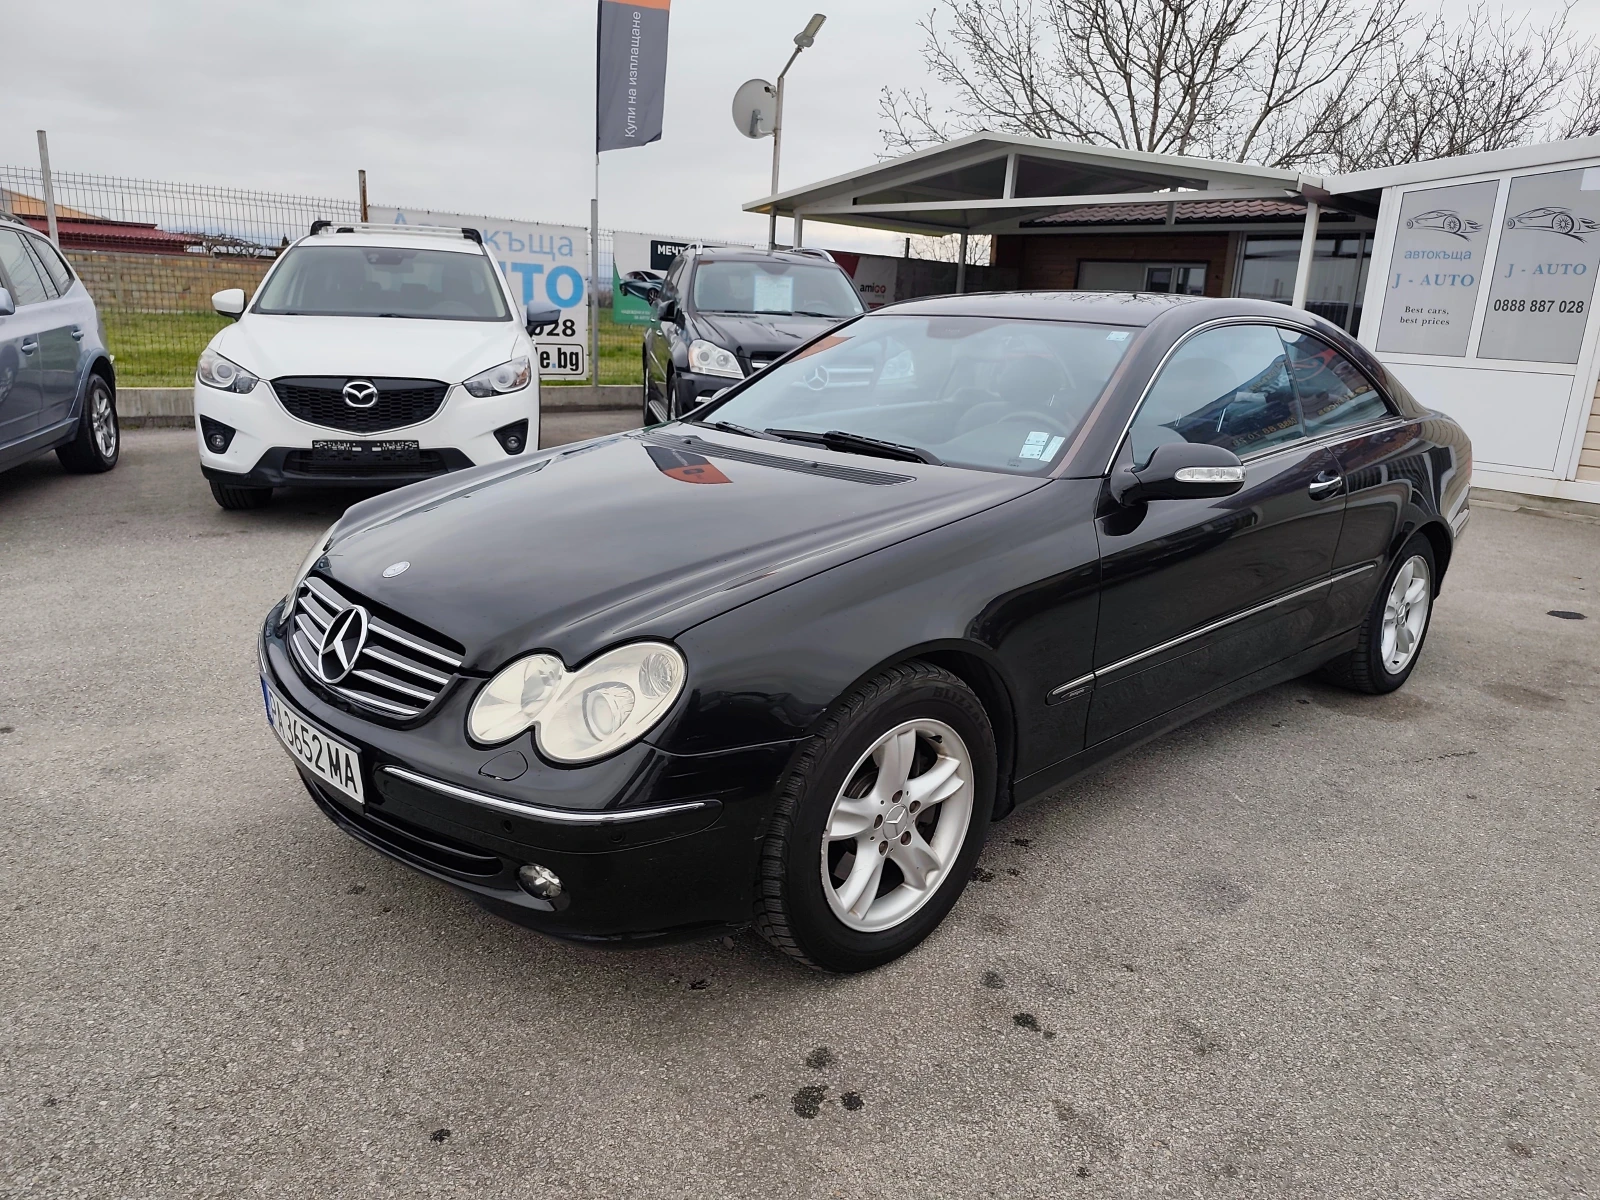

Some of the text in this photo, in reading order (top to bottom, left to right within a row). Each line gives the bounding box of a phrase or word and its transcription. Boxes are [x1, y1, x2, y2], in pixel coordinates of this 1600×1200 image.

[625, 11, 642, 138] Купи на изплащане
[1404, 250, 1472, 261] автокъща
[1504, 263, 1515, 278] J
[1532, 263, 1587, 275] AUTO
[1391, 273, 1402, 289] J
[1420, 273, 1475, 287] AUTO
[1404, 305, 1424, 314] Best
[1493, 299, 1585, 314] 0888 887 028
[1400, 316, 1450, 326] best prices
[535, 346, 580, 372] e.bg
